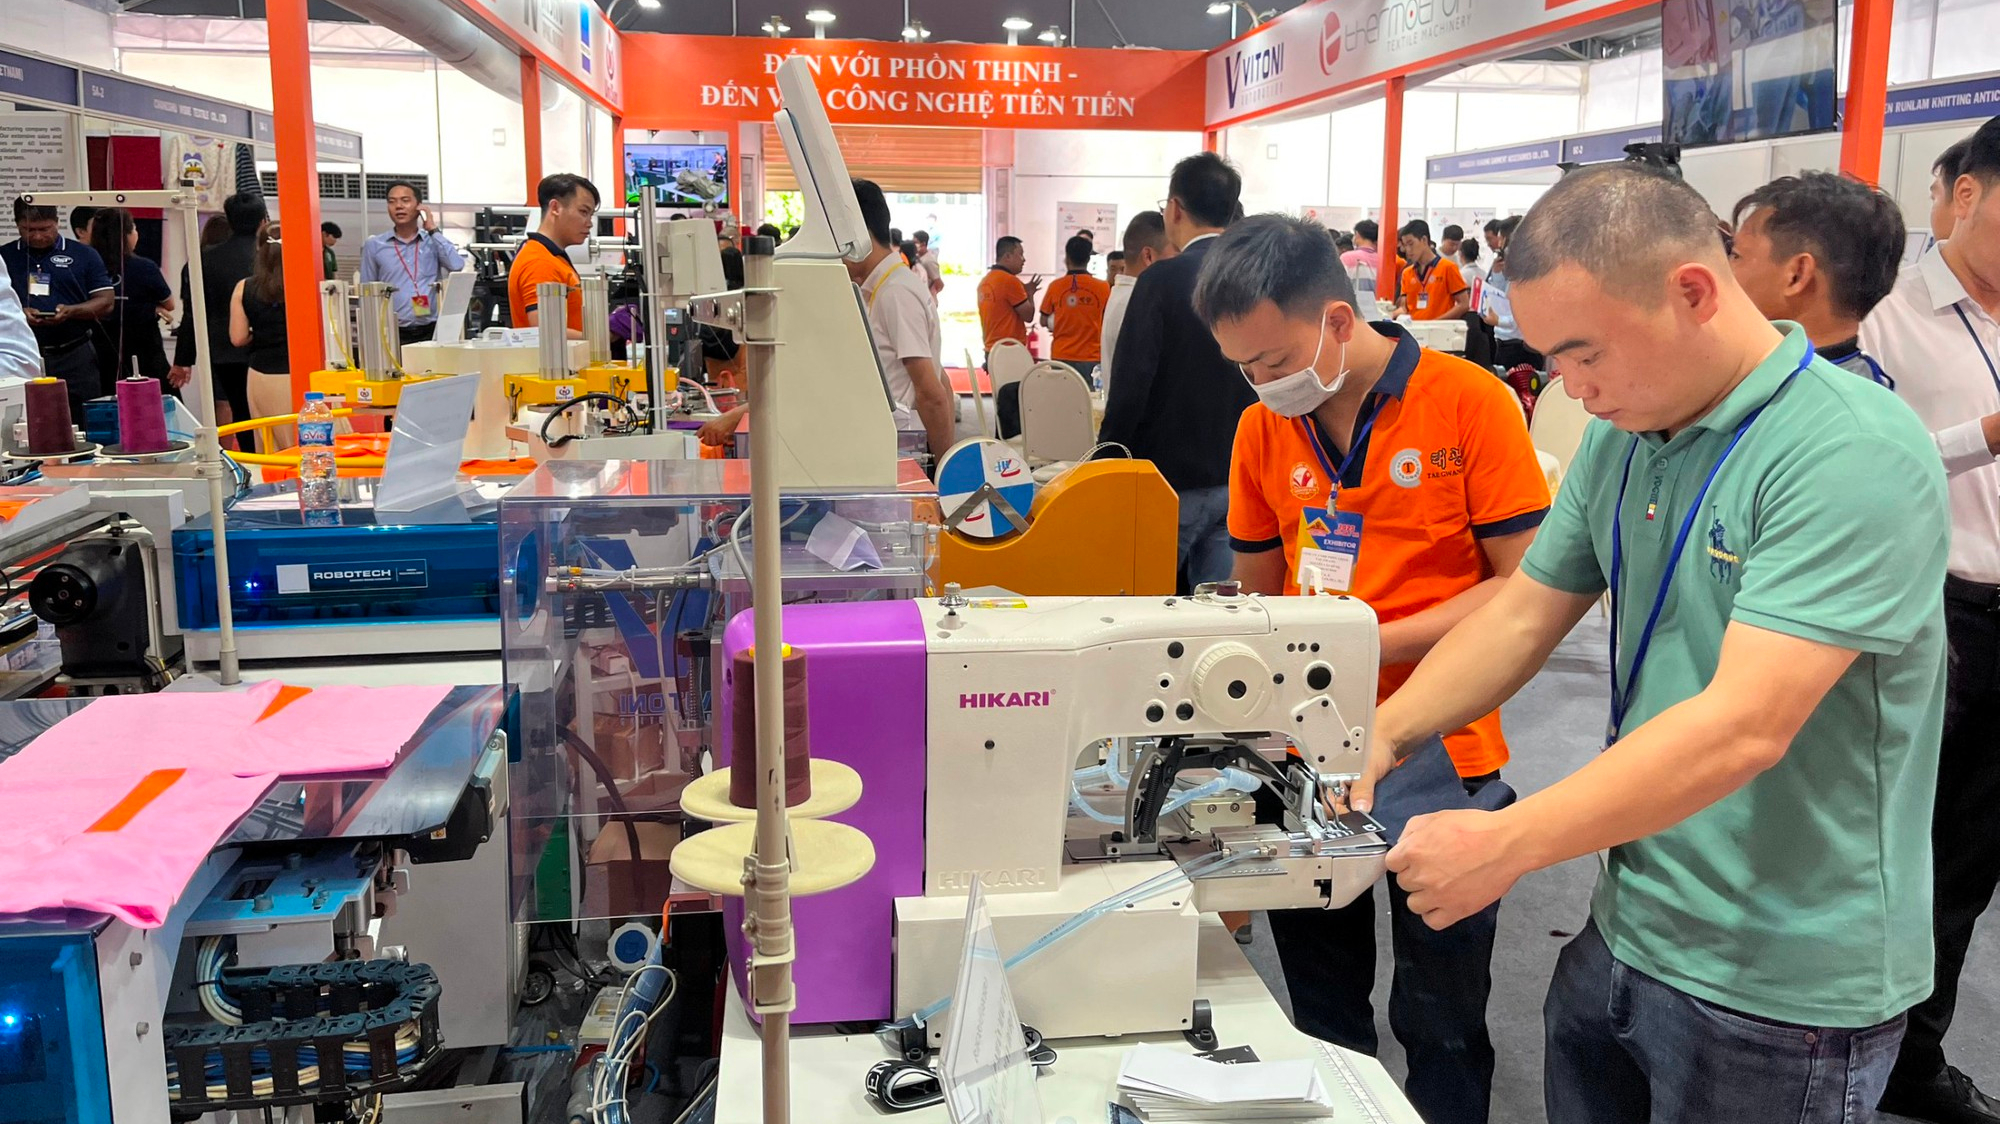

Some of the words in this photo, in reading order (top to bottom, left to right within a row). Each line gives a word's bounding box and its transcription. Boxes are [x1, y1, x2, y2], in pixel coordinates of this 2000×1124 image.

[1387, 32, 1418, 52] TEXTILE
[1421, 14, 1472, 41] MACHINERY
[763, 48, 822, 76] ĐN
[829, 50, 880, 77] VỚI
[889, 53, 966, 80] PHỒN
[973, 60, 1062, 87] THỊNH
[1243, 42, 1284, 87] VITONI
[701, 80, 760, 107] ĐẾN
[827, 83, 908, 112] CÔNG
[916, 90, 994, 119] NGHỆ
[1001, 88, 1065, 116] TIÊN
[1072, 91, 1135, 117] TIẾN
[1895, 97, 1929, 113] RUNLAM
[1931, 92, 1972, 109] KNITTING
[1323, 538, 1357, 549] EXHIBITOR
[313, 569, 391, 580] ROBOTECH
[959, 691, 1049, 709] HIKARI
[938, 867, 1046, 890] HIKARI
